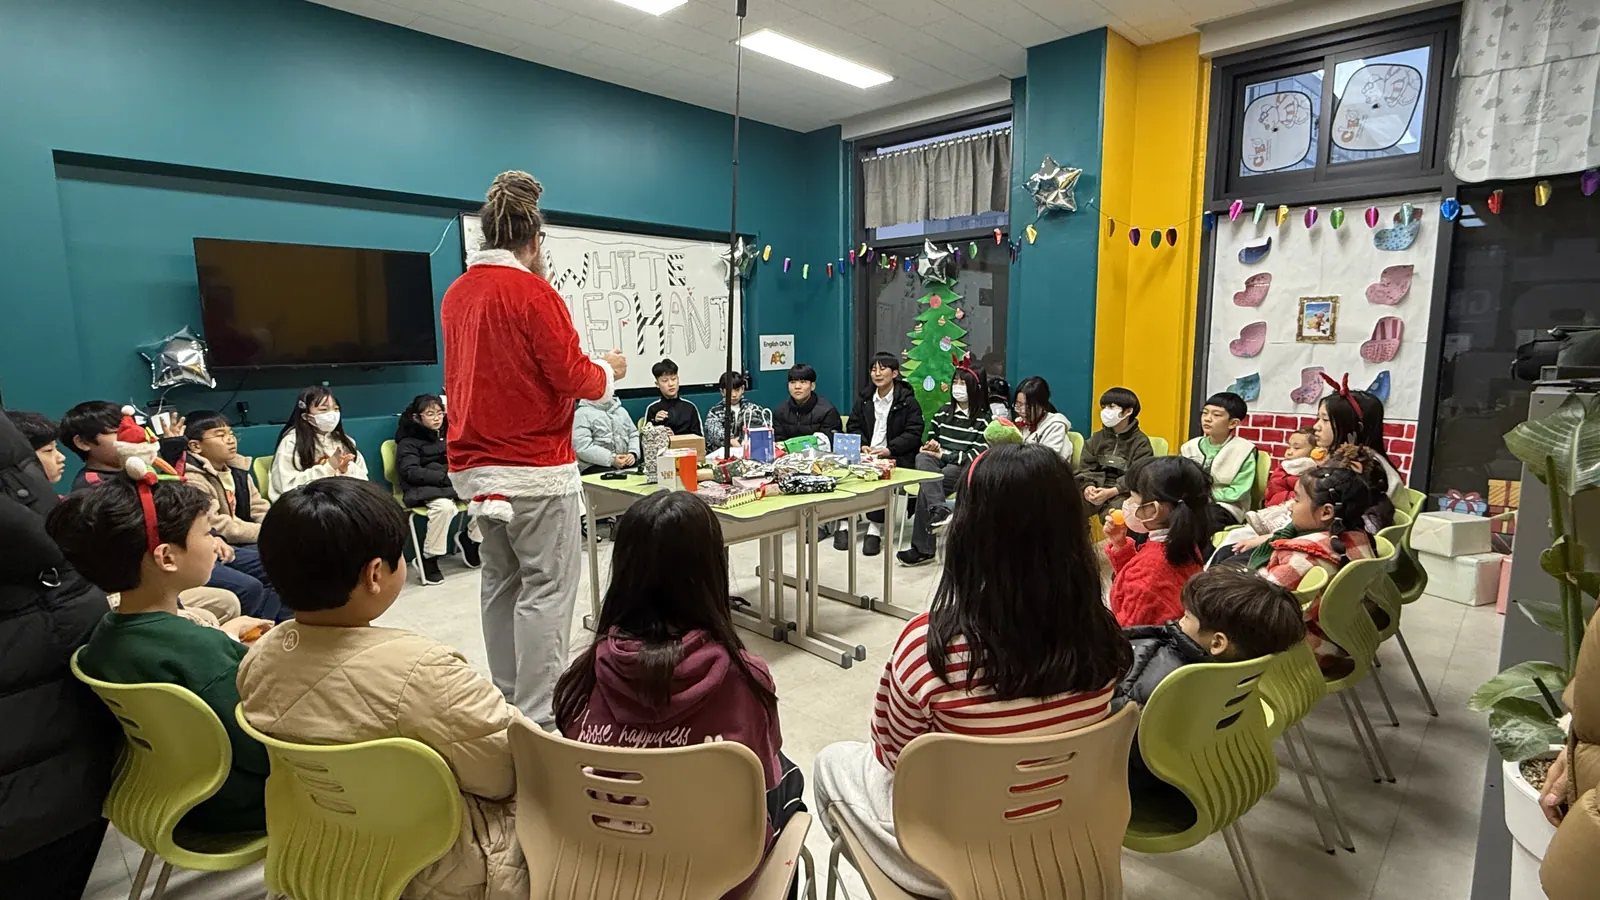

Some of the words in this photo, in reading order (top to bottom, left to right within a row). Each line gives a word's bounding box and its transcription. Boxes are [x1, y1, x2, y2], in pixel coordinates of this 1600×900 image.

[546, 250, 686, 291] WHITE
[562, 290, 728, 359] EPHANT
[575, 705, 613, 743] hoose
